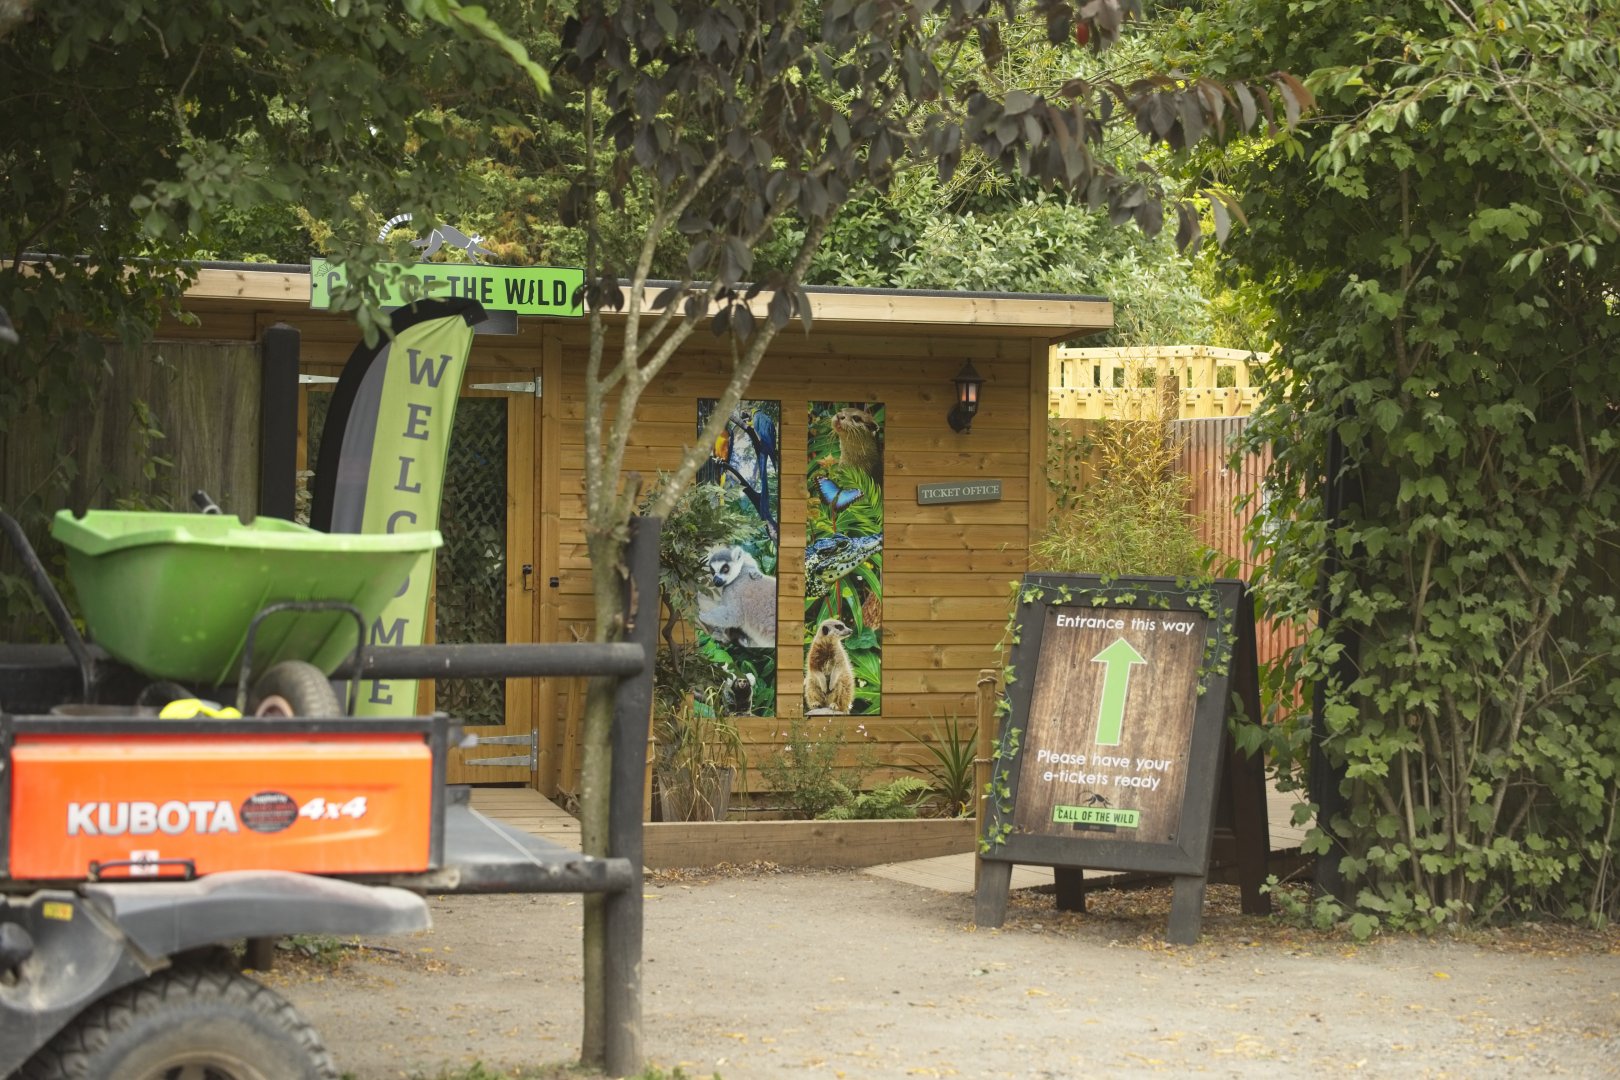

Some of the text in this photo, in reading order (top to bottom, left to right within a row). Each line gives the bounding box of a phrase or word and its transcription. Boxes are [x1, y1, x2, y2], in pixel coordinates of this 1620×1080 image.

[450, 276, 493, 303] THE
[505, 277, 567, 306] WILD
[921, 485, 1000, 499] TICKET OFFICE
[367, 348, 452, 705] WELCME
[1056, 614, 1195, 635] Entrance this way
[1037, 749, 1172, 772] Please have your
[1043, 770, 1160, 791] e-tickets ready
[66, 800, 240, 836] KUBOTA
[299, 796, 368, 821] 4x4
[1057, 809, 1134, 824] CALL OF THE WILD
